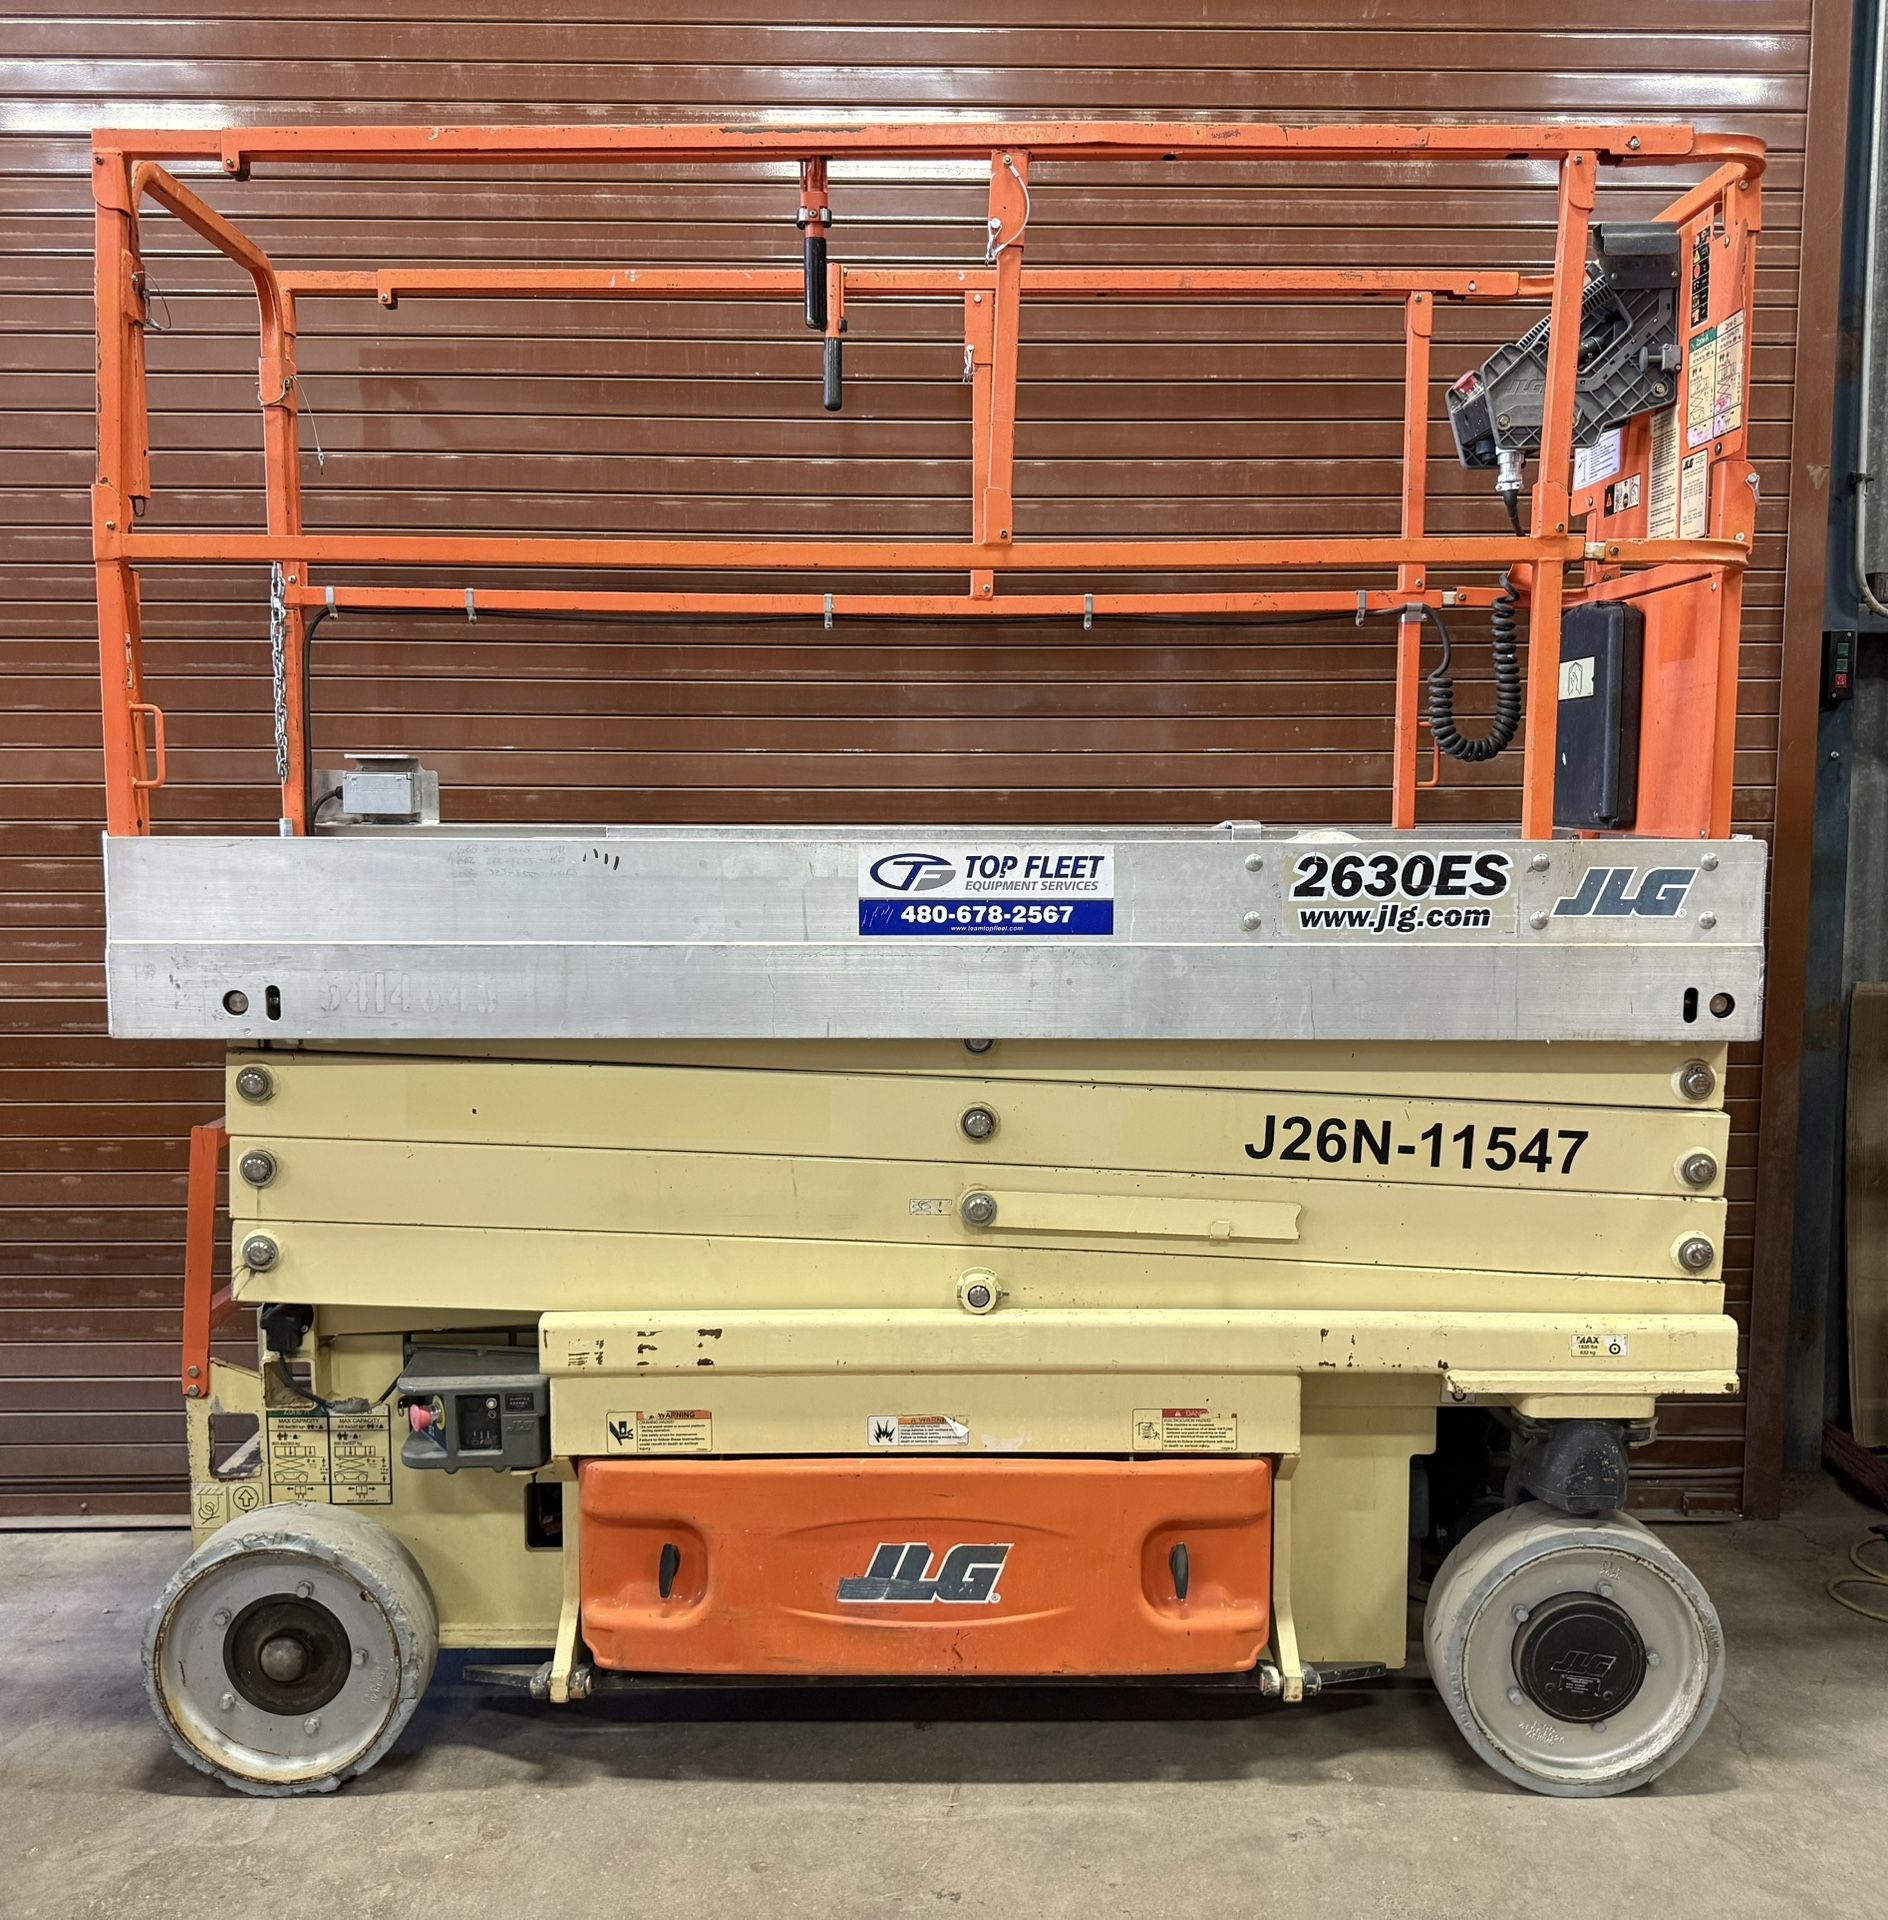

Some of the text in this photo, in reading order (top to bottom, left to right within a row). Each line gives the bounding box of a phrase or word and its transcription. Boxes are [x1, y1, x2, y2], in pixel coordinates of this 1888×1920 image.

[965, 855, 1105, 879] TOP FLEET
[1290, 852, 1512, 900] 2630ES
[965, 880, 1099, 892] EQUIPMENT SERVICES
[1551, 866, 1702, 918] JLG
[900, 904, 1074, 924] 480-678-2567
[1297, 903, 1492, 934] www.jlg.com
[1244, 1114, 1590, 1175] J26N-11547
[1576, 1335, 1600, 1345] MAX
[657, 1410, 696, 1419] WARNING
[836, 1542, 1016, 1604] JLG
[1550, 1650, 1617, 1678] JLG
